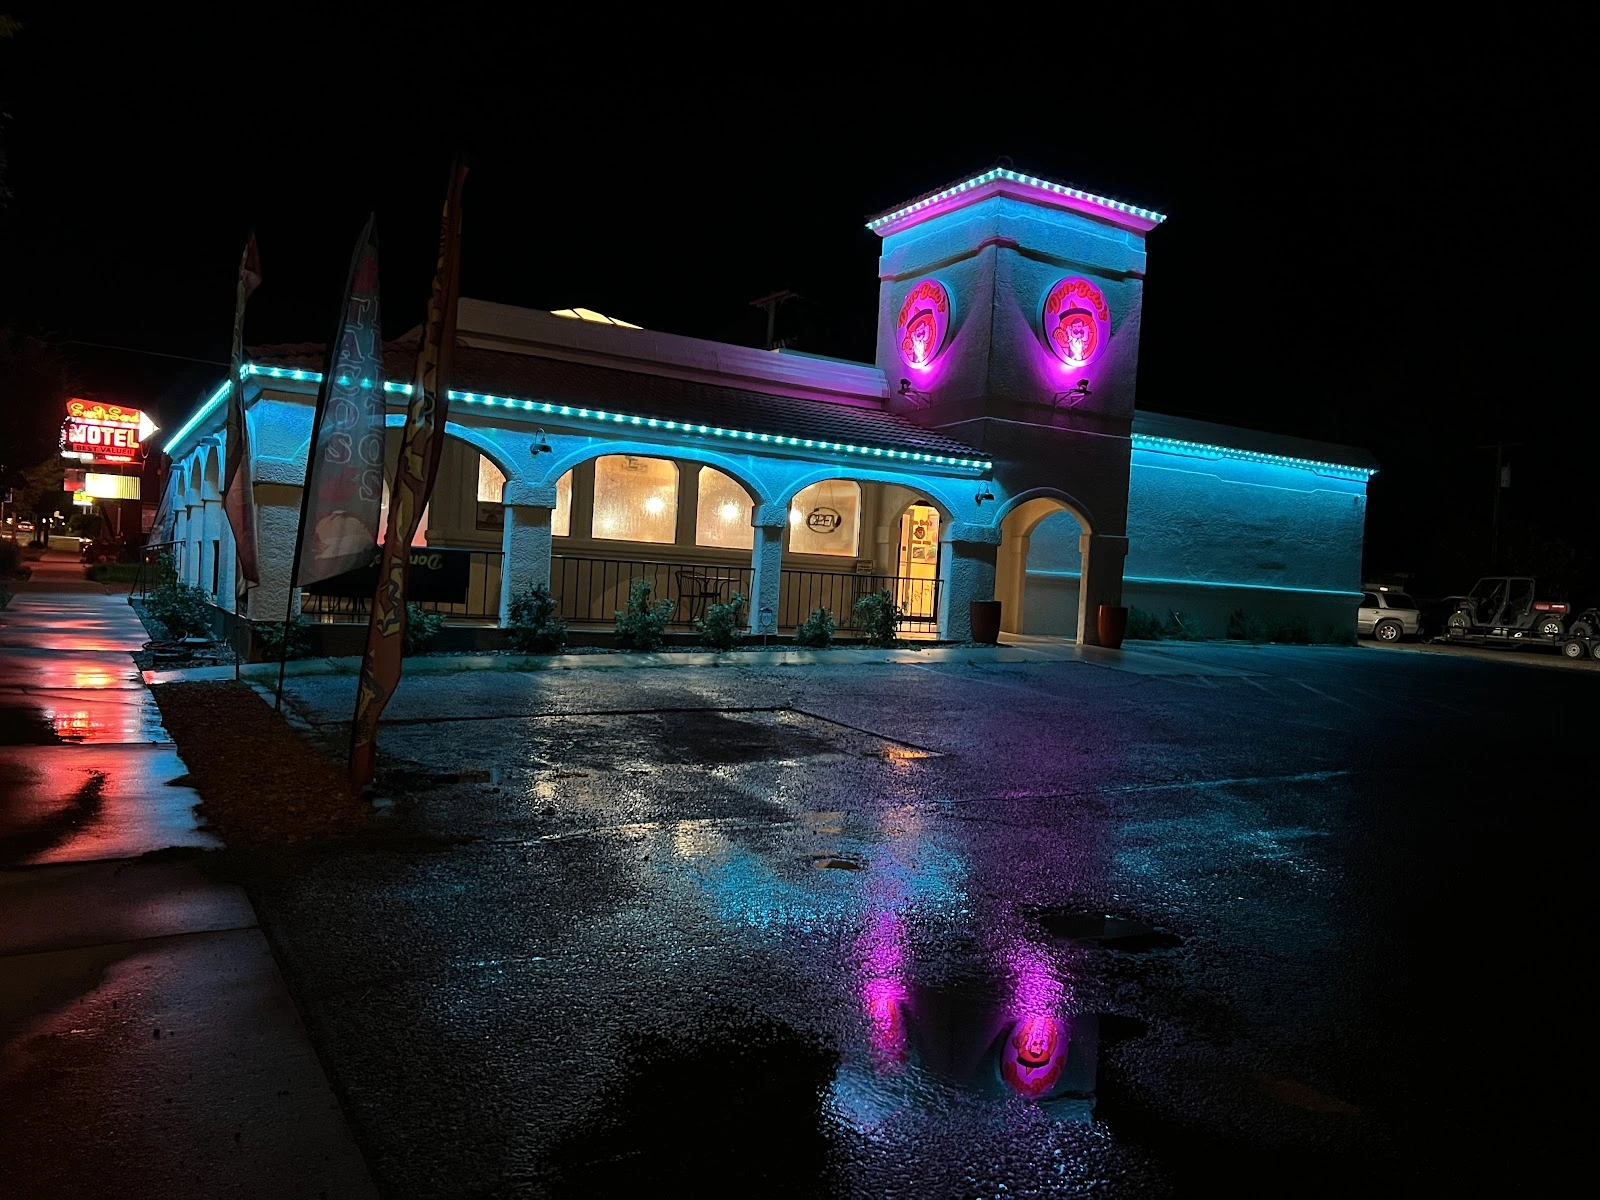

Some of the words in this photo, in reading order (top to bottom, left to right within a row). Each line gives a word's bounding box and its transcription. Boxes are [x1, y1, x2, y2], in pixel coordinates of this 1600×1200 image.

[897, 290, 919, 329] Don
[1047, 282, 1075, 314] Don
[1074, 280, 1108, 321] Beto's
[325, 296, 370, 464] TACOS
[68, 423, 140, 448] MOTEL
[76, 444, 98, 452] BEST
[808, 513, 837, 526] OPEN
